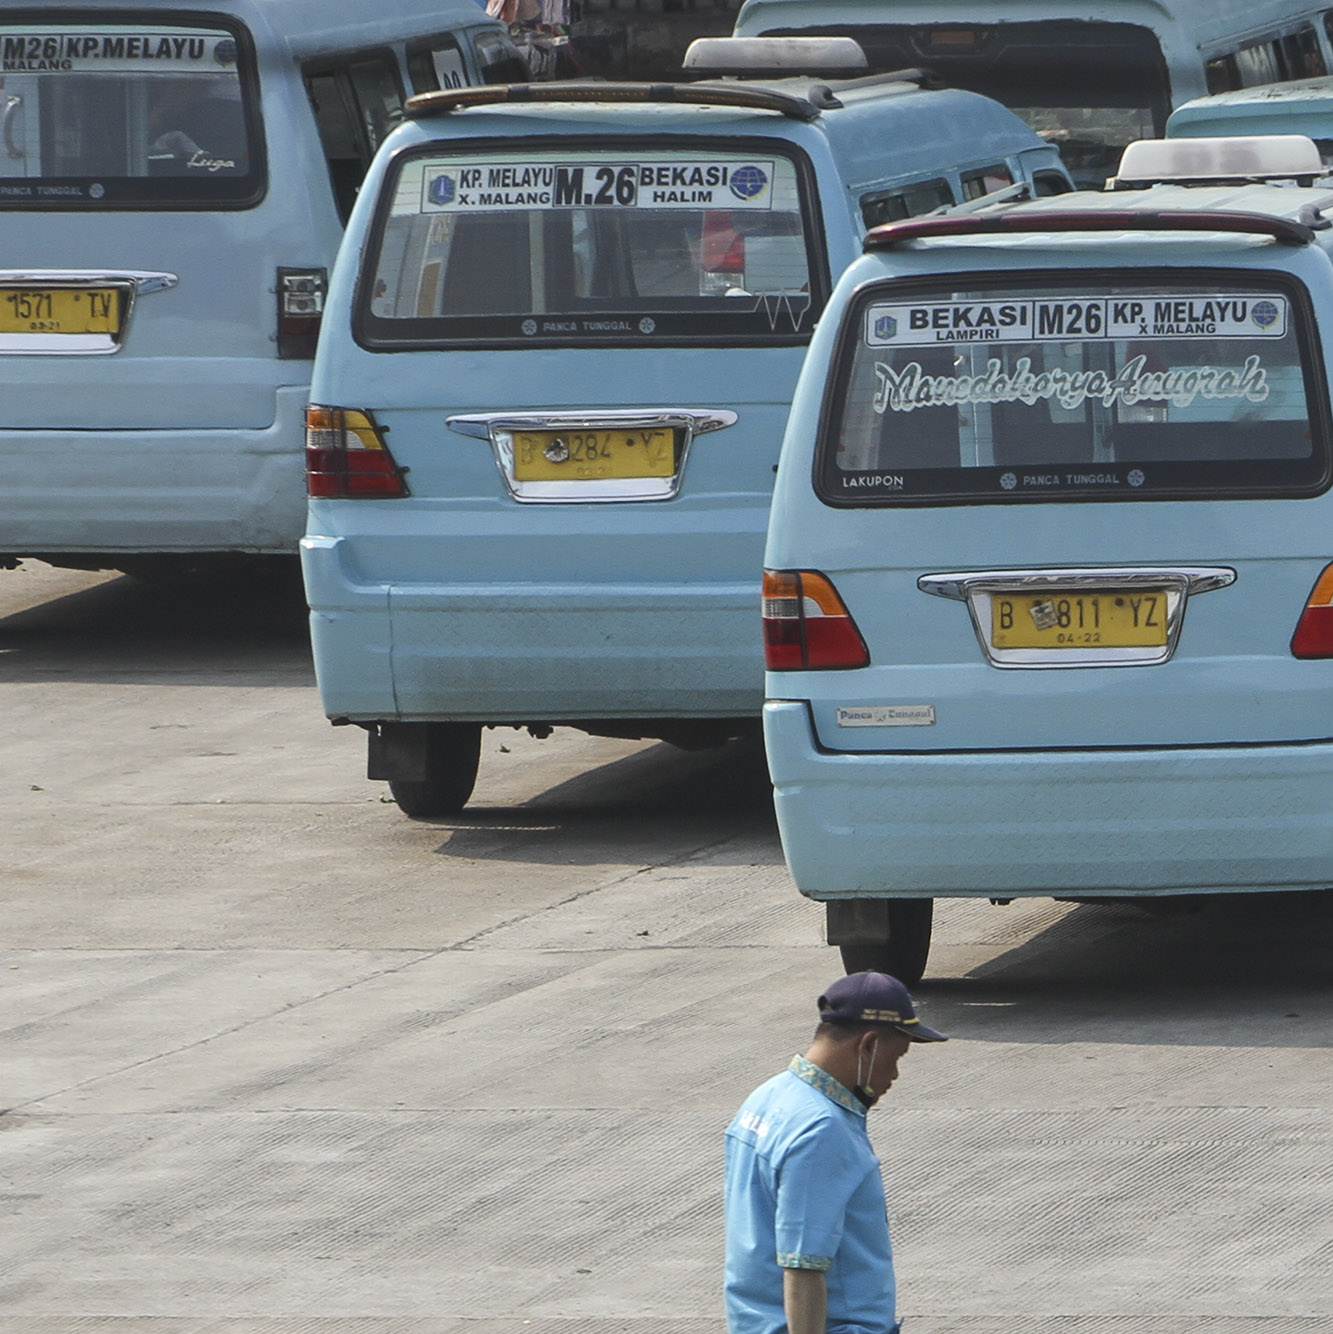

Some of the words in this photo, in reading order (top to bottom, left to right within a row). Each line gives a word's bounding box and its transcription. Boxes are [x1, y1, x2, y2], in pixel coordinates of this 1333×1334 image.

[3, 37, 57, 60] M26
[65, 37, 205, 60] KP.MELAYU
[3, 59, 72, 70] MALANG
[460, 168, 483, 188] KP.
[488, 167, 552, 188] MELAYU
[640, 167, 728, 187] BEKASI
[555, 167, 636, 207] M.26
[653, 190, 712, 203] HALIM
[479, 191, 550, 205] MALANG
[12, 293, 52, 318] 1571
[87, 292, 111, 318] TV
[543, 322, 577, 331] PANCA
[583, 321, 632, 331] TUNGGAL
[909, 304, 1027, 329] BEKASI
[1039, 303, 1100, 335] M26
[1113, 302, 1144, 324] KP.
[1154, 301, 1247, 324] MELAYU
[936, 328, 1000, 341] LAMPIRI
[1139, 323, 1148, 334] X
[1153, 323, 1216, 334] MALANG
[843, 475, 903, 487] LAKUPON
[1023, 475, 1059, 486] PANCA
[1066, 473, 1119, 485] TUNGGAL
[1001, 601, 1013, 629] B
[1130, 597, 1158, 627] YZ
